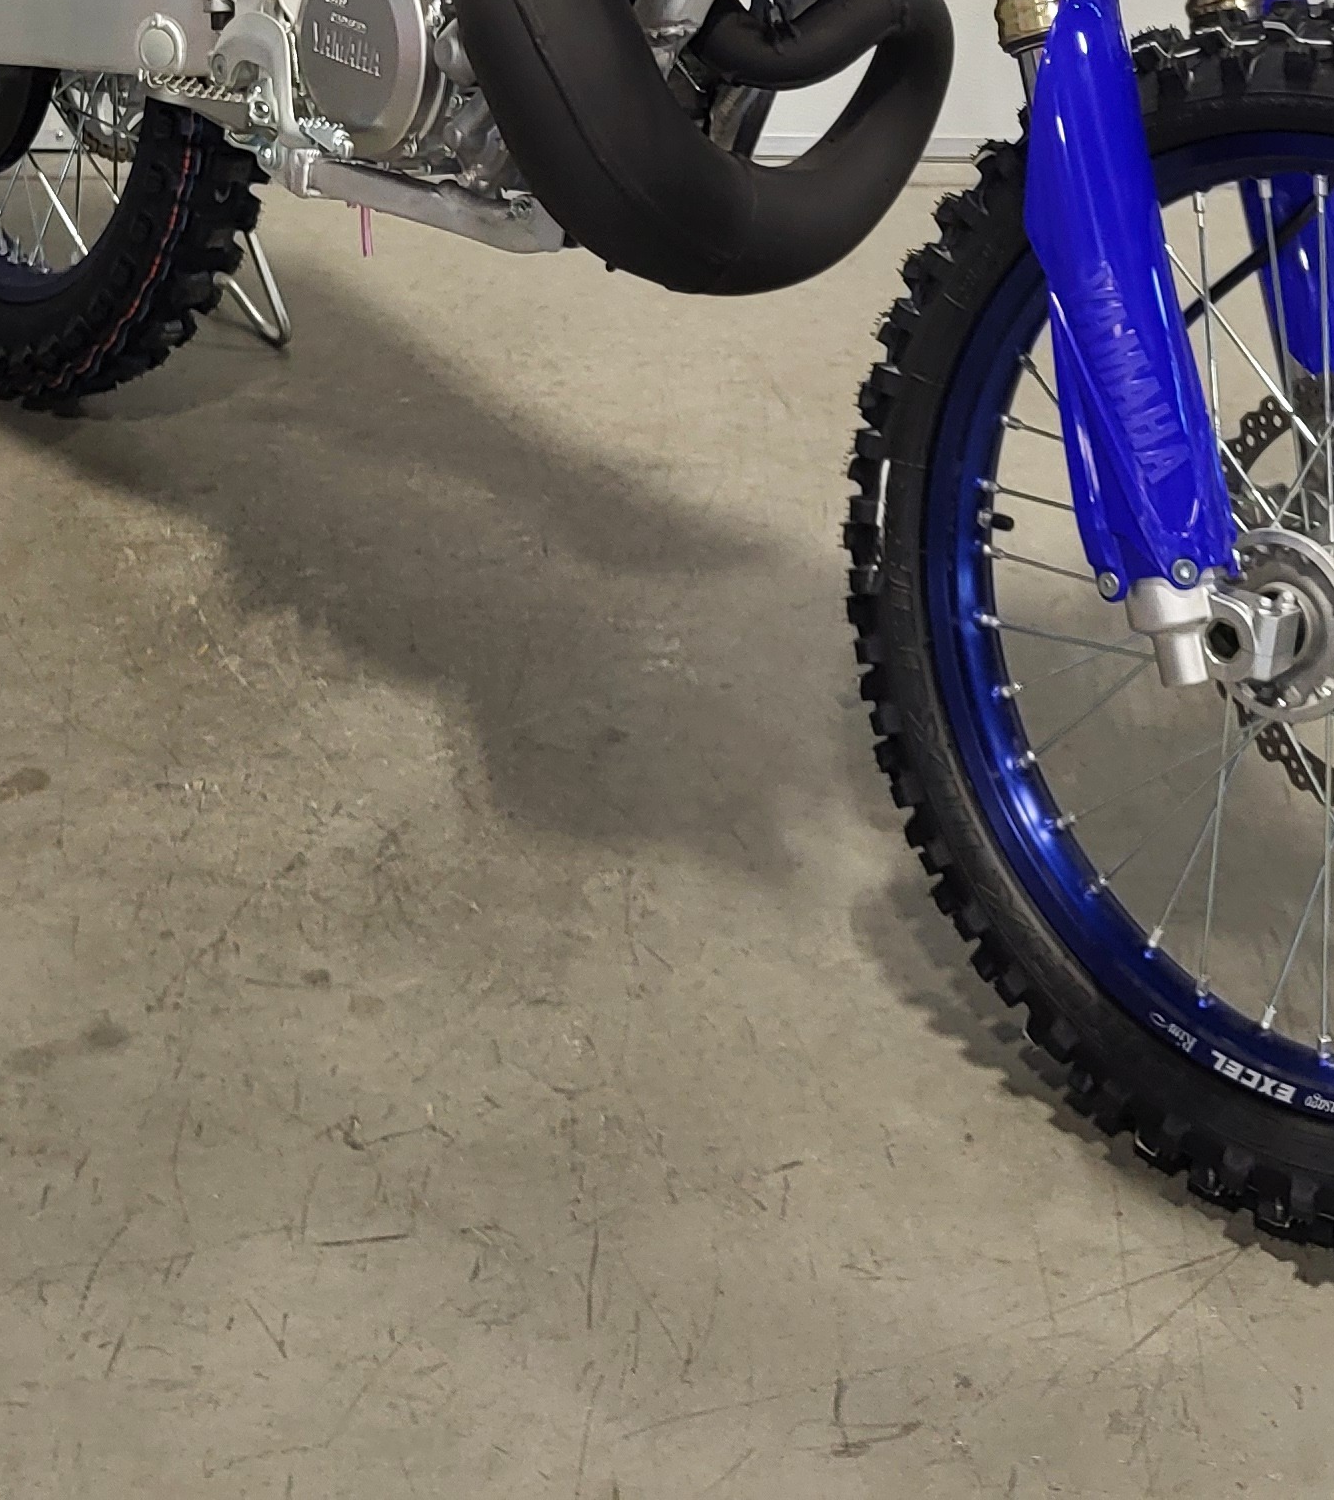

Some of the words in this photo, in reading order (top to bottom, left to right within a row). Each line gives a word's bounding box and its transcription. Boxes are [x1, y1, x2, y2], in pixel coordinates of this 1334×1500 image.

[312, 21, 381, 77] YAMAHA
[1070, 260, 1192, 486] YAMAHA
[1211, 1049, 1298, 1104] EXCEL
